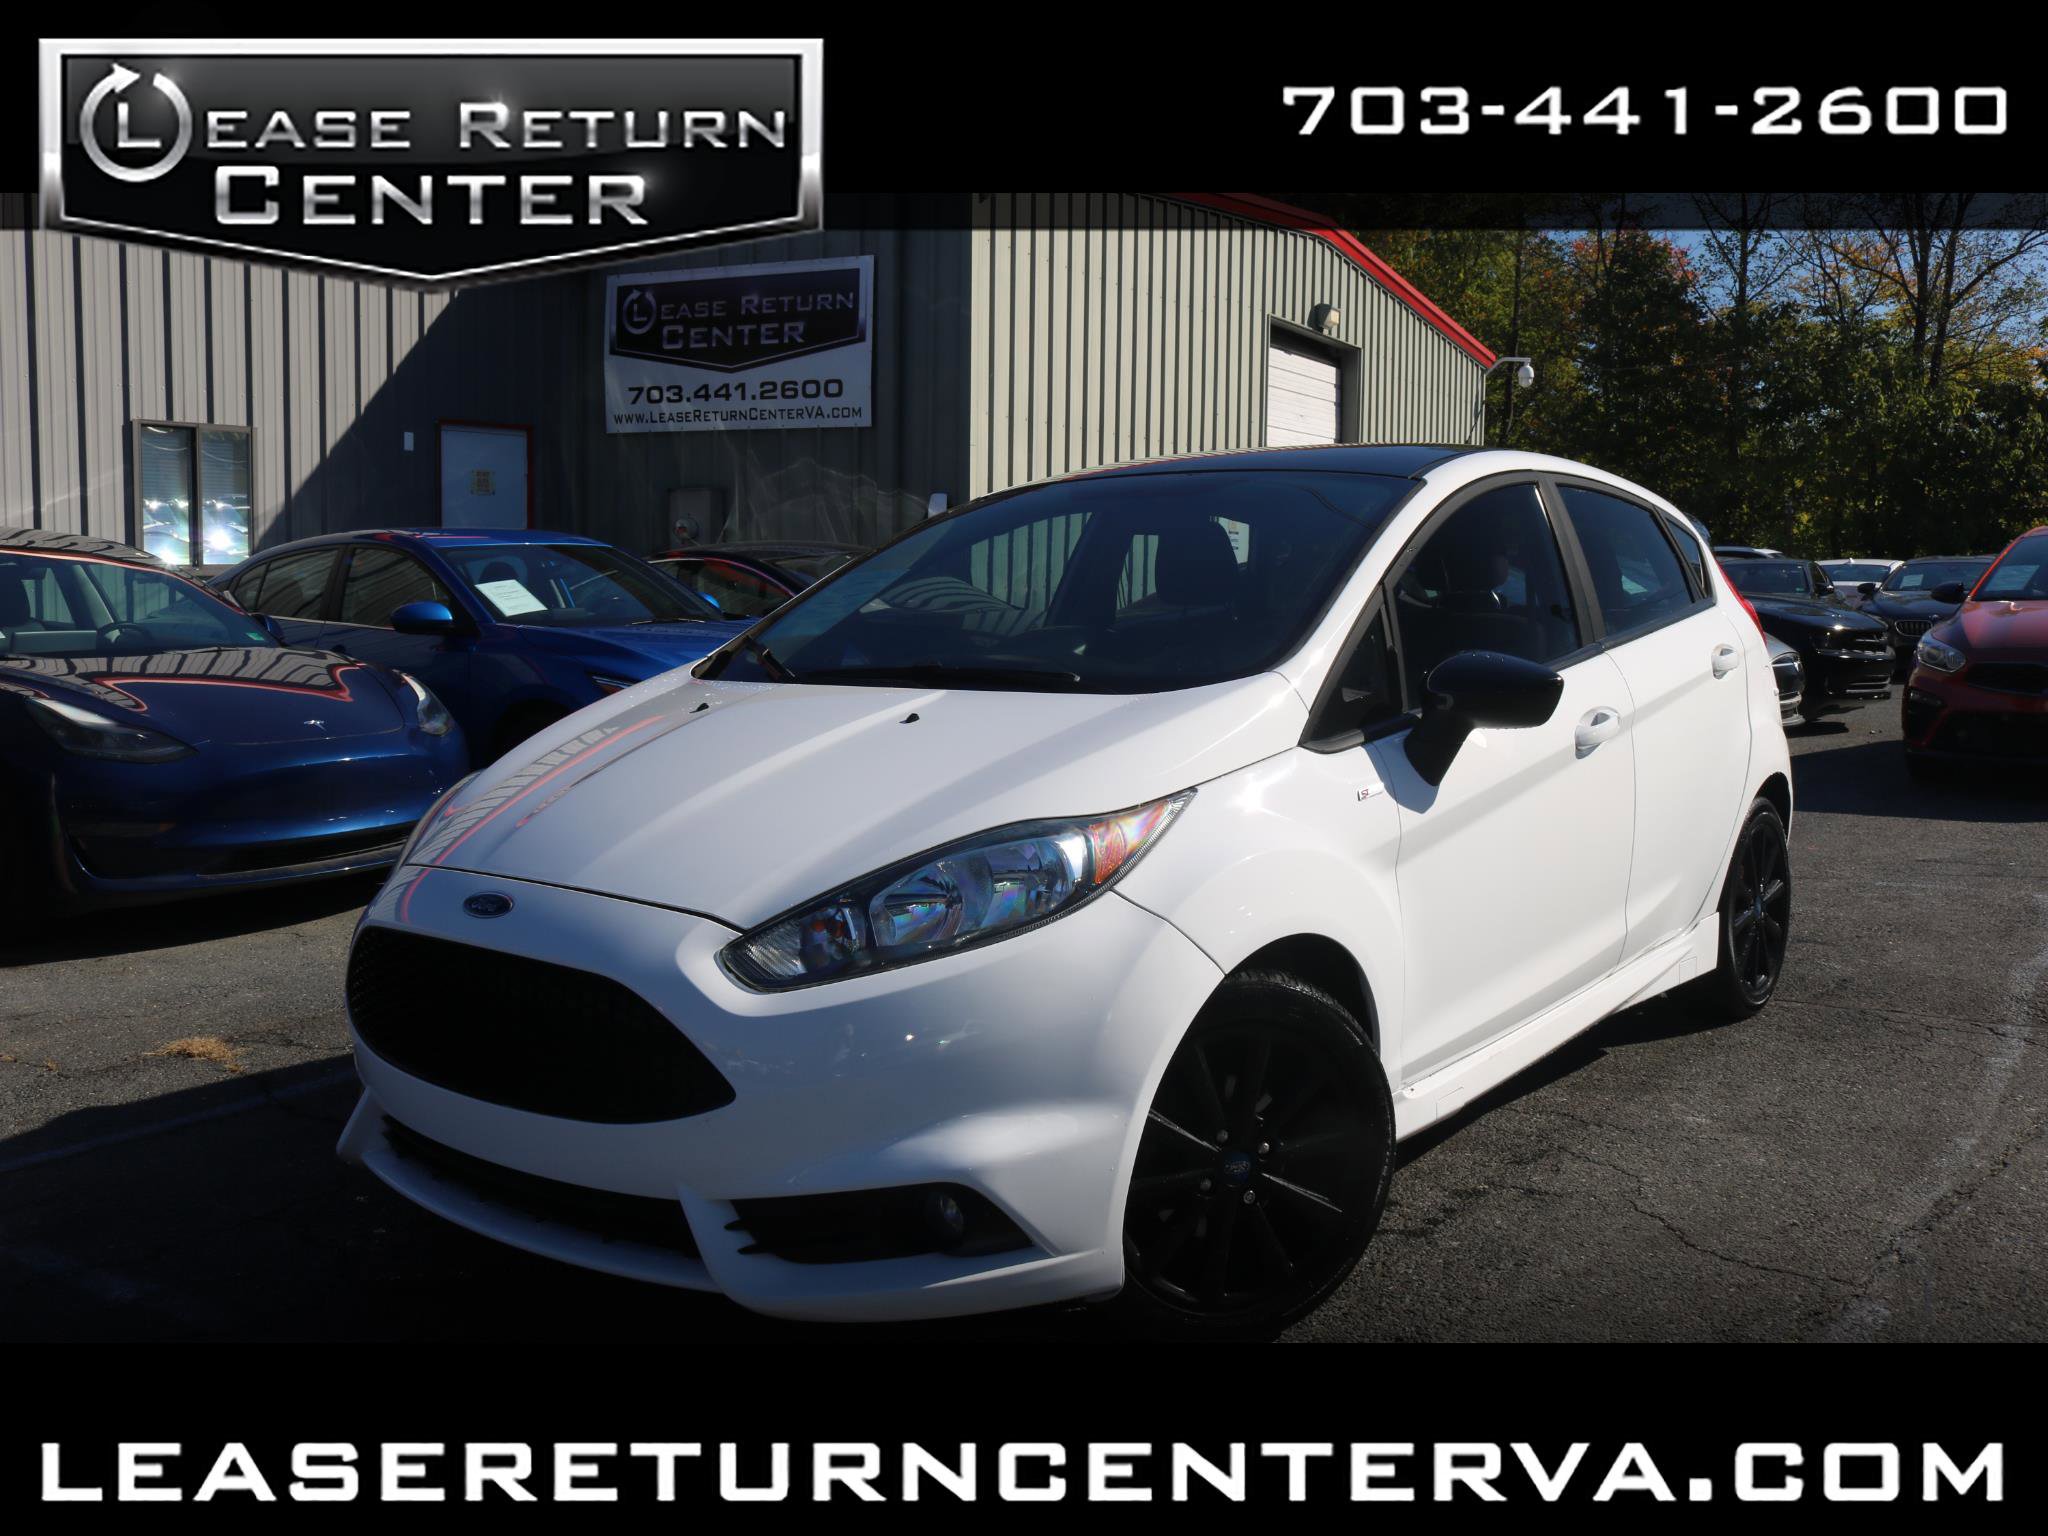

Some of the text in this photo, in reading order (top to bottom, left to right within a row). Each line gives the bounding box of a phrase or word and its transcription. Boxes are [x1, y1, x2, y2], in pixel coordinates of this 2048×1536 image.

[740, 292, 854, 315] RETURN
[661, 321, 805, 350] CENTER
[628, 379, 844, 405] 703.441.2600
